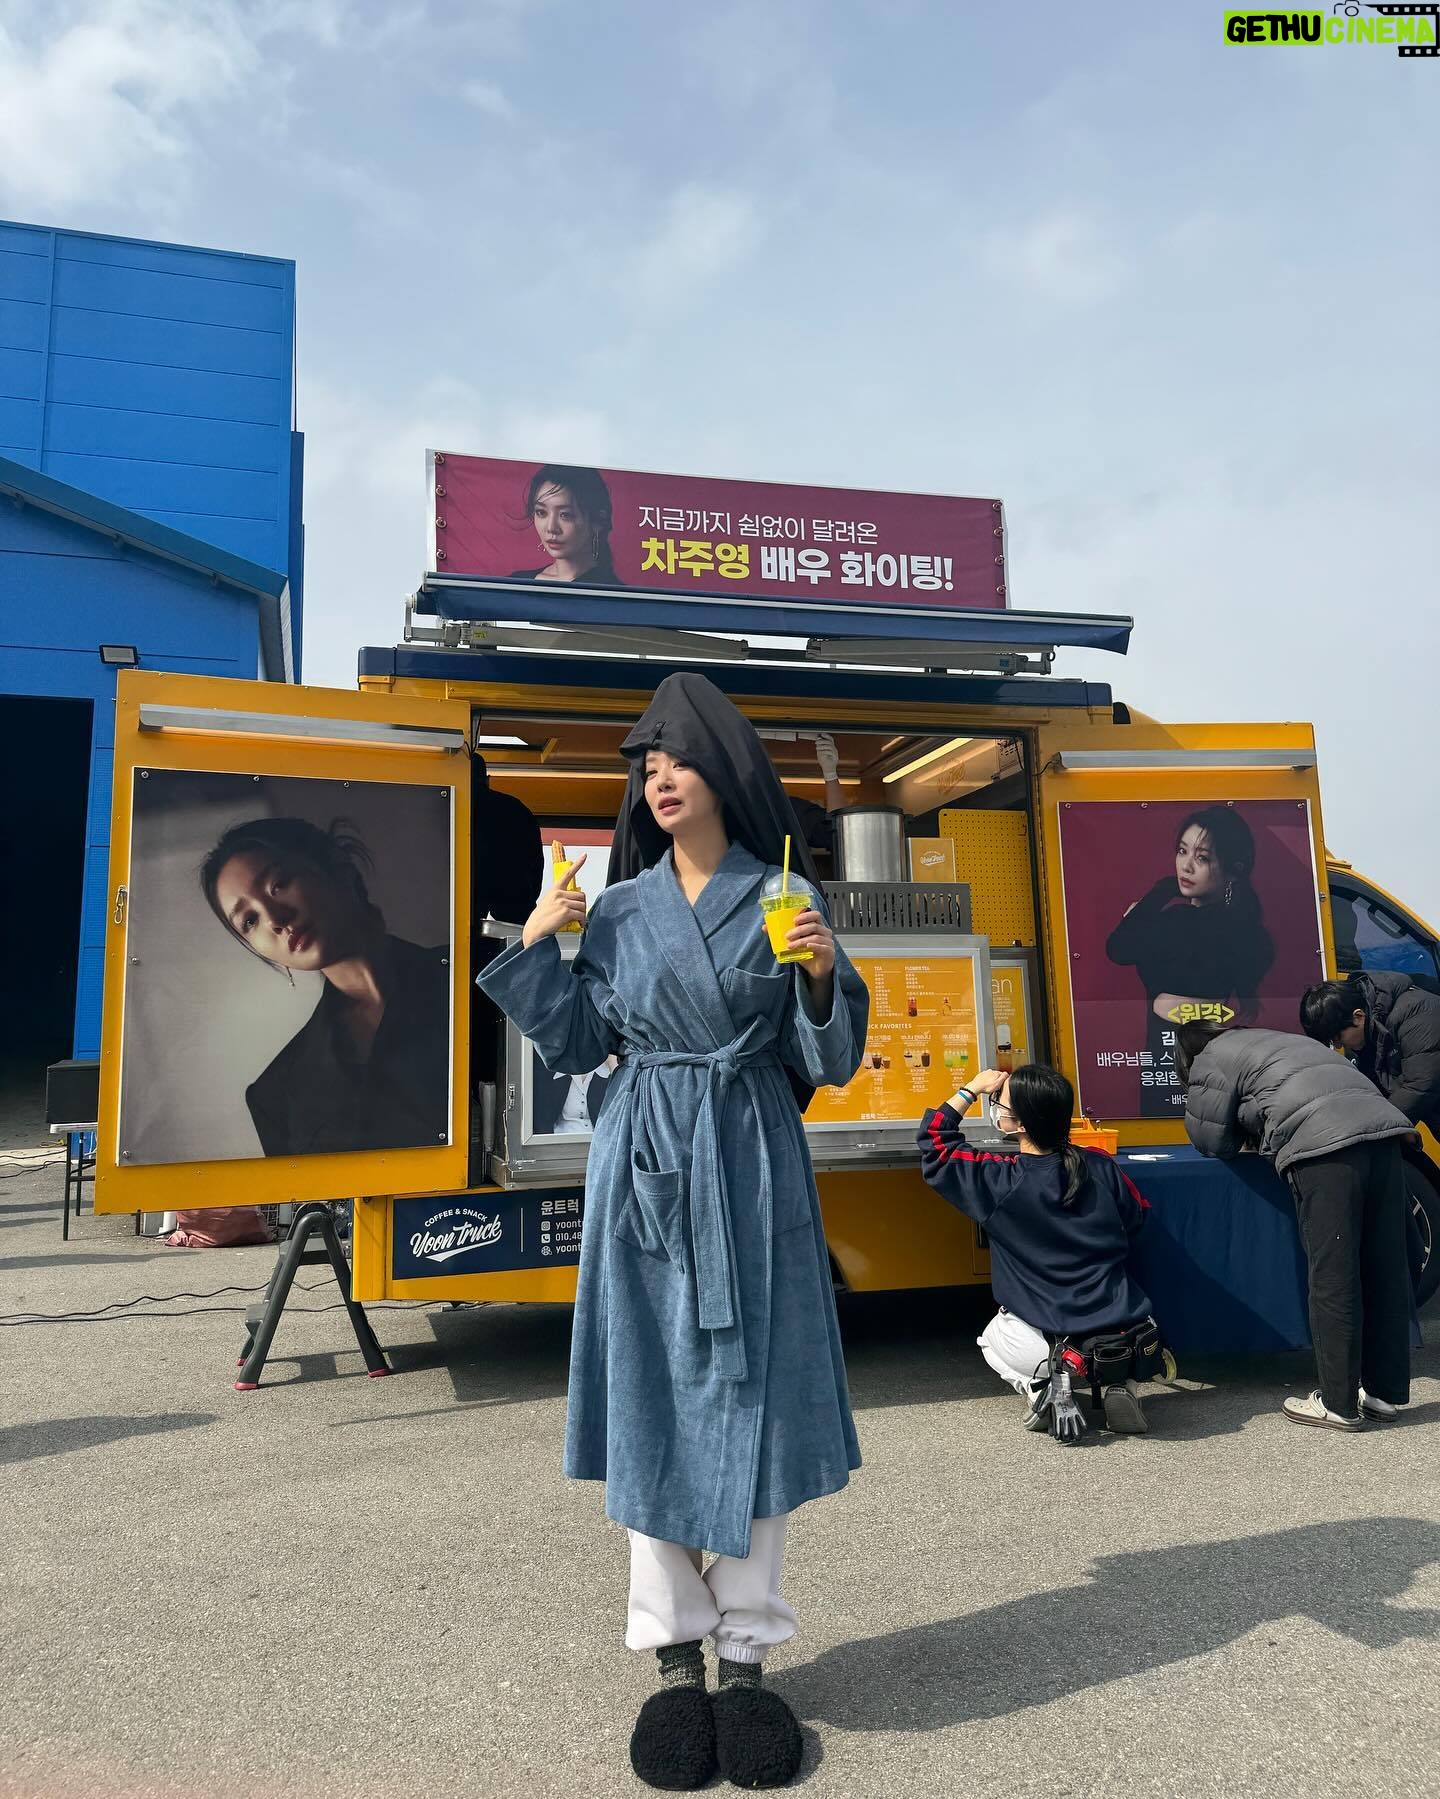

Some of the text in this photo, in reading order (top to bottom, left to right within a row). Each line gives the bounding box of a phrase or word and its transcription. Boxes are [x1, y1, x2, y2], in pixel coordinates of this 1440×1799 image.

[638, 506, 879, 545] 지금까지 쉼없이 달려온
[641, 537, 954, 591] 차주영 배우 화이팅!
[1161, 1031, 1175, 1046] 김
[1096, 1051, 1176, 1067] 배우님들, 스
[541, 1199, 579, 1216] 윤트럭
[424, 1209, 454, 1227] COFFEE
[462, 1208, 488, 1222] SNACK
[555, 1219, 583, 1230] yoont
[410, 1231, 456, 1257] Yoon
